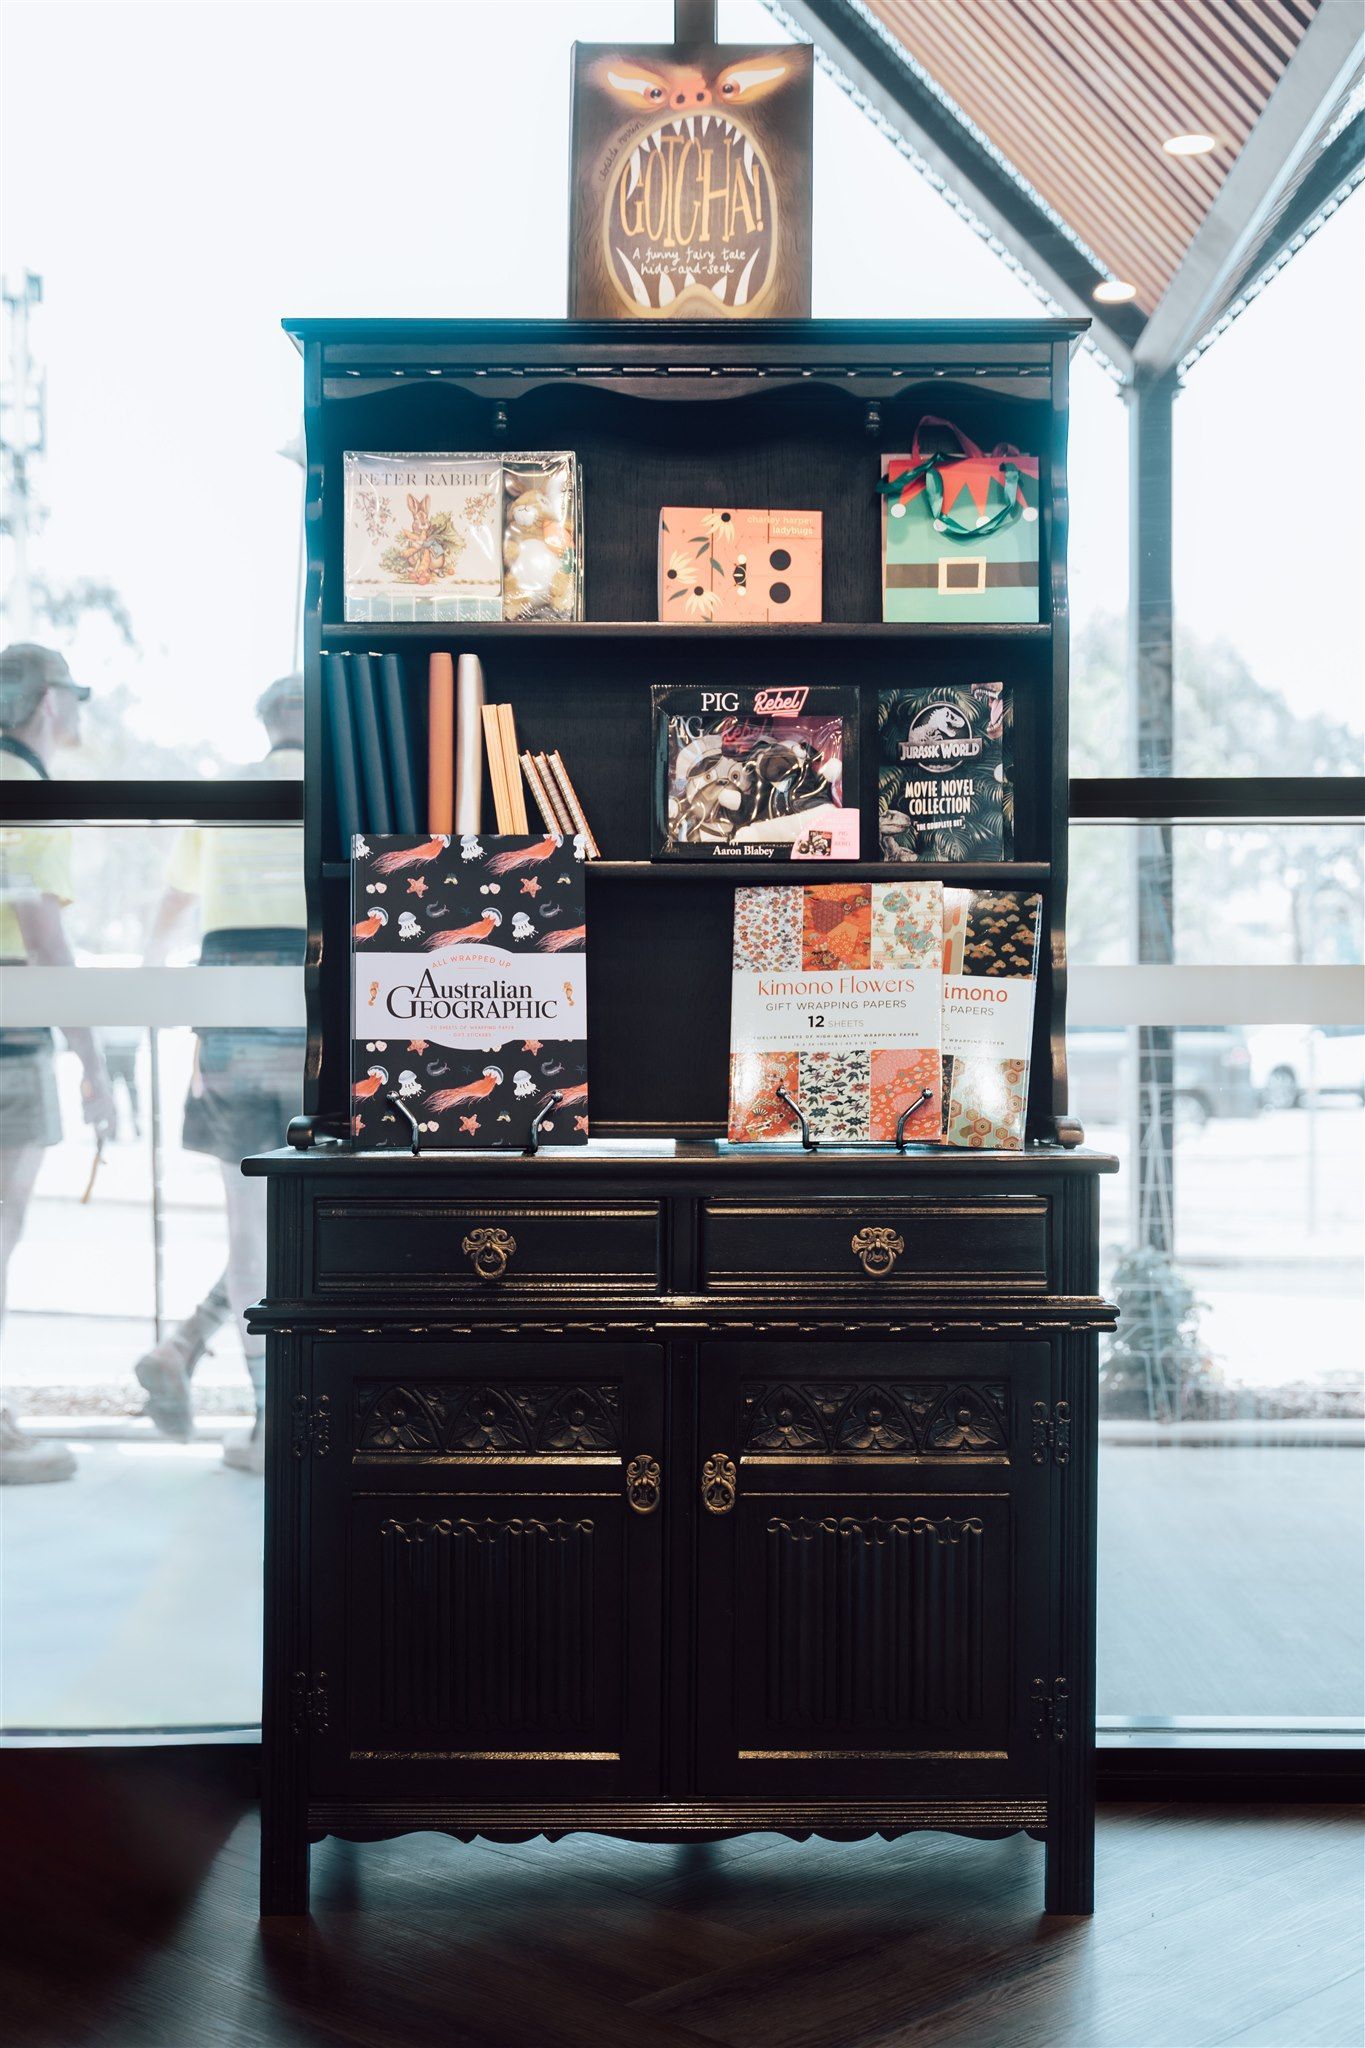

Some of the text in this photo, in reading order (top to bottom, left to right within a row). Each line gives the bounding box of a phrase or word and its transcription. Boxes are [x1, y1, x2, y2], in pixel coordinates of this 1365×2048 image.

[619, 135, 764, 248] GOTCHA!
[632, 247, 746, 265] A funny fairy tale
[640, 262, 735, 276] hide-and-seek
[358, 473, 493, 487] PETER RABBIT
[772, 525, 813, 537] ladybugs
[701, 690, 800, 712] PIG Rebel
[900, 742, 980, 761] JURASSIC WORLD
[904, 778, 975, 798] MOVIE NOVEL
[908, 796, 971, 816] COLLECTION
[712, 845, 774, 858] Aaron Blabey
[431, 955, 512, 969] ALL WRAPPED UP
[413, 967, 532, 999] Australian
[757, 975, 915, 996] Kimono Flowers
[943, 982, 1008, 1003] imono
[386, 985, 558, 1019] GEOGRAPHIC
[765, 1000, 907, 1012] GIFT WRAPPING PAPERS
[950, 1005, 995, 1016] PAPERS
[807, 1015, 864, 1028] 12 SHEETS
